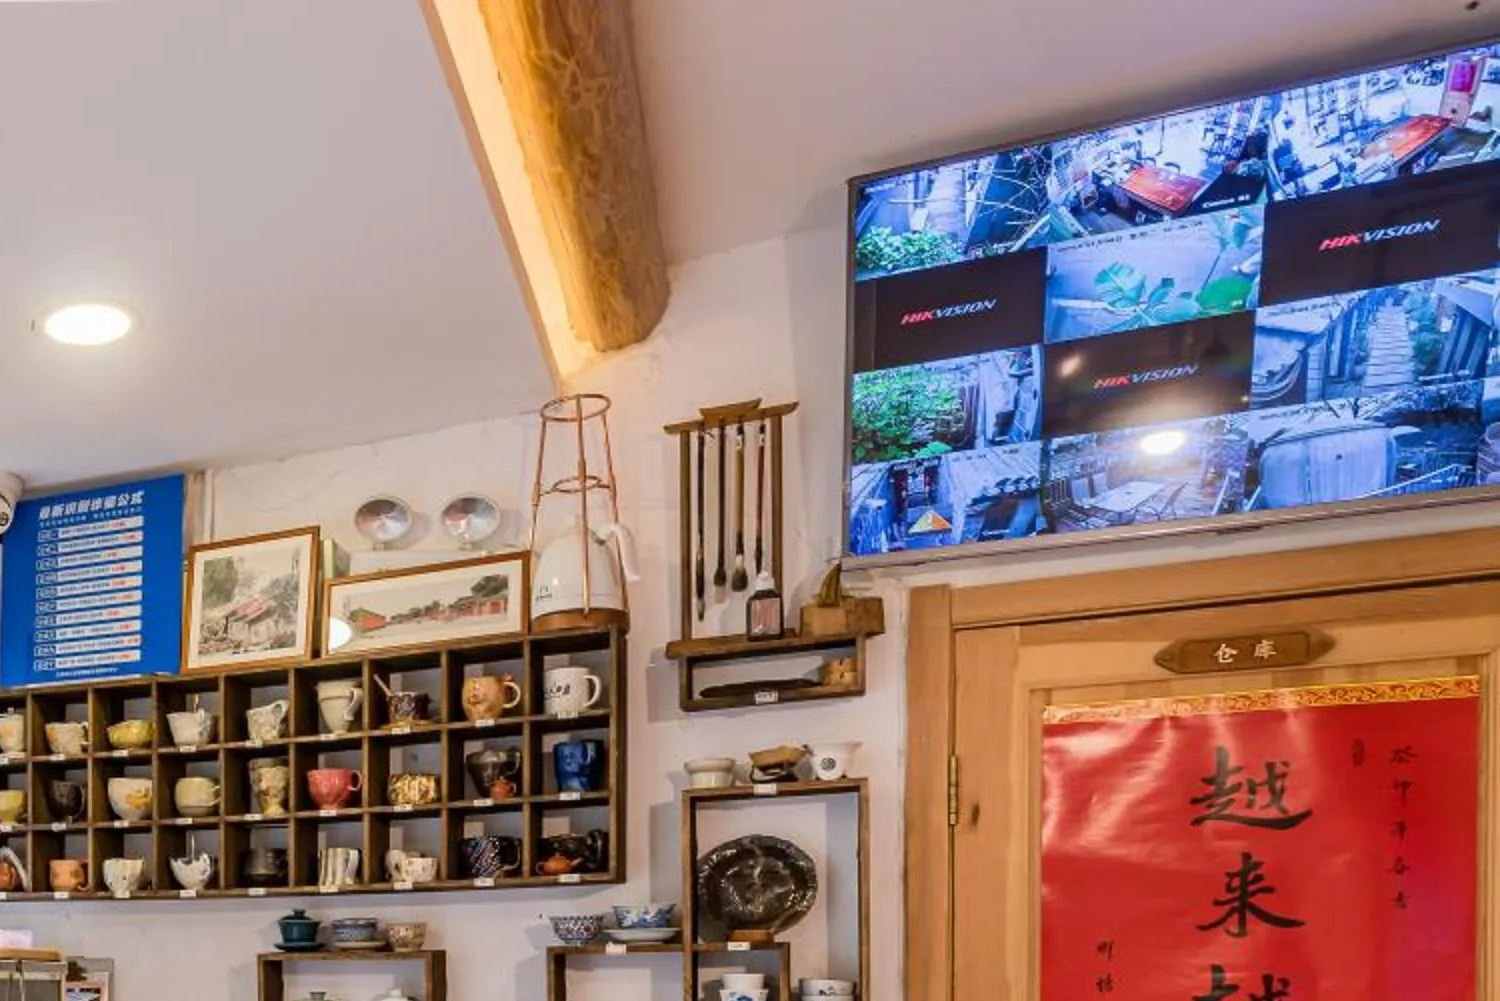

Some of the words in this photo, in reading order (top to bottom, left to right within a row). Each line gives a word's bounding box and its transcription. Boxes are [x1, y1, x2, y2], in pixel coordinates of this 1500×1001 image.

[1318, 218, 1441, 253] HIKVISION
[900, 298, 997, 326] HIKVISION
[1093, 363, 1200, 390] HIKVISION
[1213, 638, 1277, 664] 仓库
